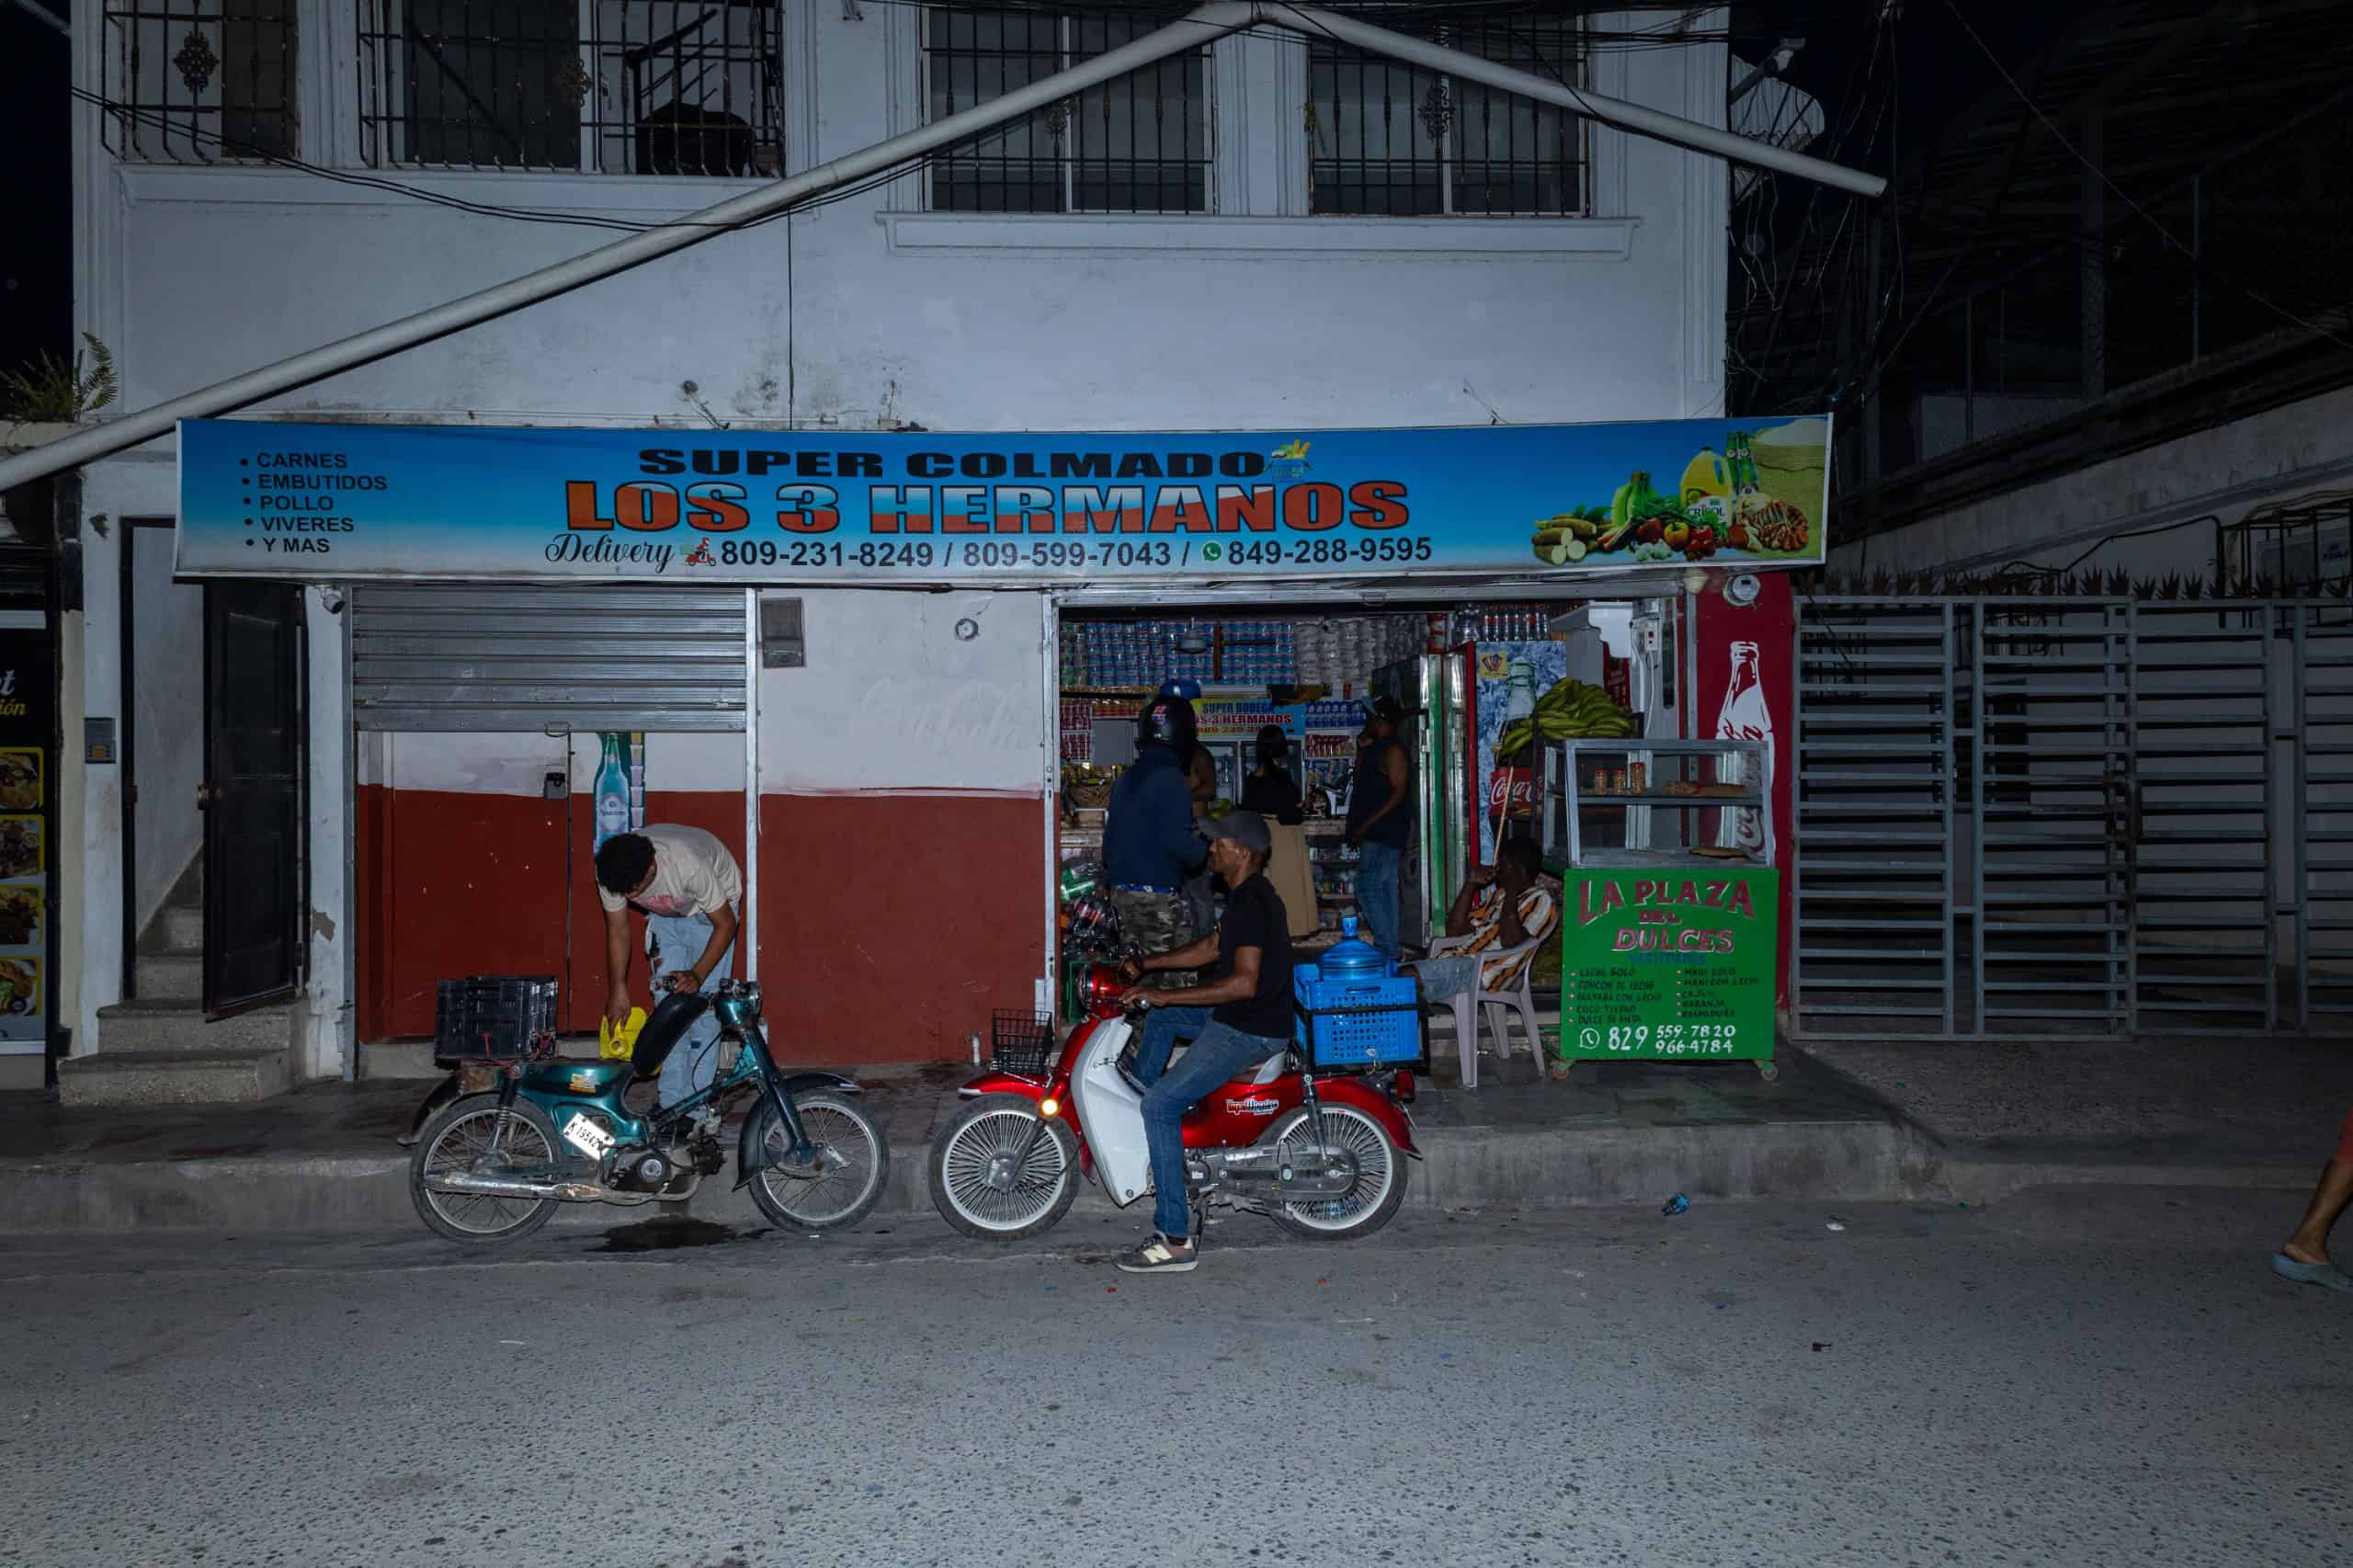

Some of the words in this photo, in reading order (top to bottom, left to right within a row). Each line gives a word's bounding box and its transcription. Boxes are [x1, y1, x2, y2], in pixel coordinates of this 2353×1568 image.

[256, 452, 347, 469] CARNES
[639, 449, 883, 478] SUPER
[905, 451, 1265, 479] COLMADO
[258, 473, 388, 490] EMBUTIDOS
[260, 495, 334, 511] POLLO
[565, 479, 751, 532] LOS
[775, 483, 840, 534] 3
[869, 480, 1409, 534] HERMANOS
[260, 517, 355, 532] VIVERES
[263, 538, 277, 552] Y
[283, 538, 331, 553] MAS
[545, 532, 674, 574] Delivery
[721, 540, 934, 568] 809-231-8249
[962, 540, 1171, 567] 809-599-7043
[1227, 536, 1432, 565] 849-288-9595
[1579, 880, 1626, 928] LA
[1635, 880, 1756, 920] PLAZA
[1638, 910, 1682, 925] DEL
[1611, 928, 1735, 953] DULCES
[1608, 1026, 1648, 1051] 829
[1655, 1040, 1733, 1053] 966-4784
